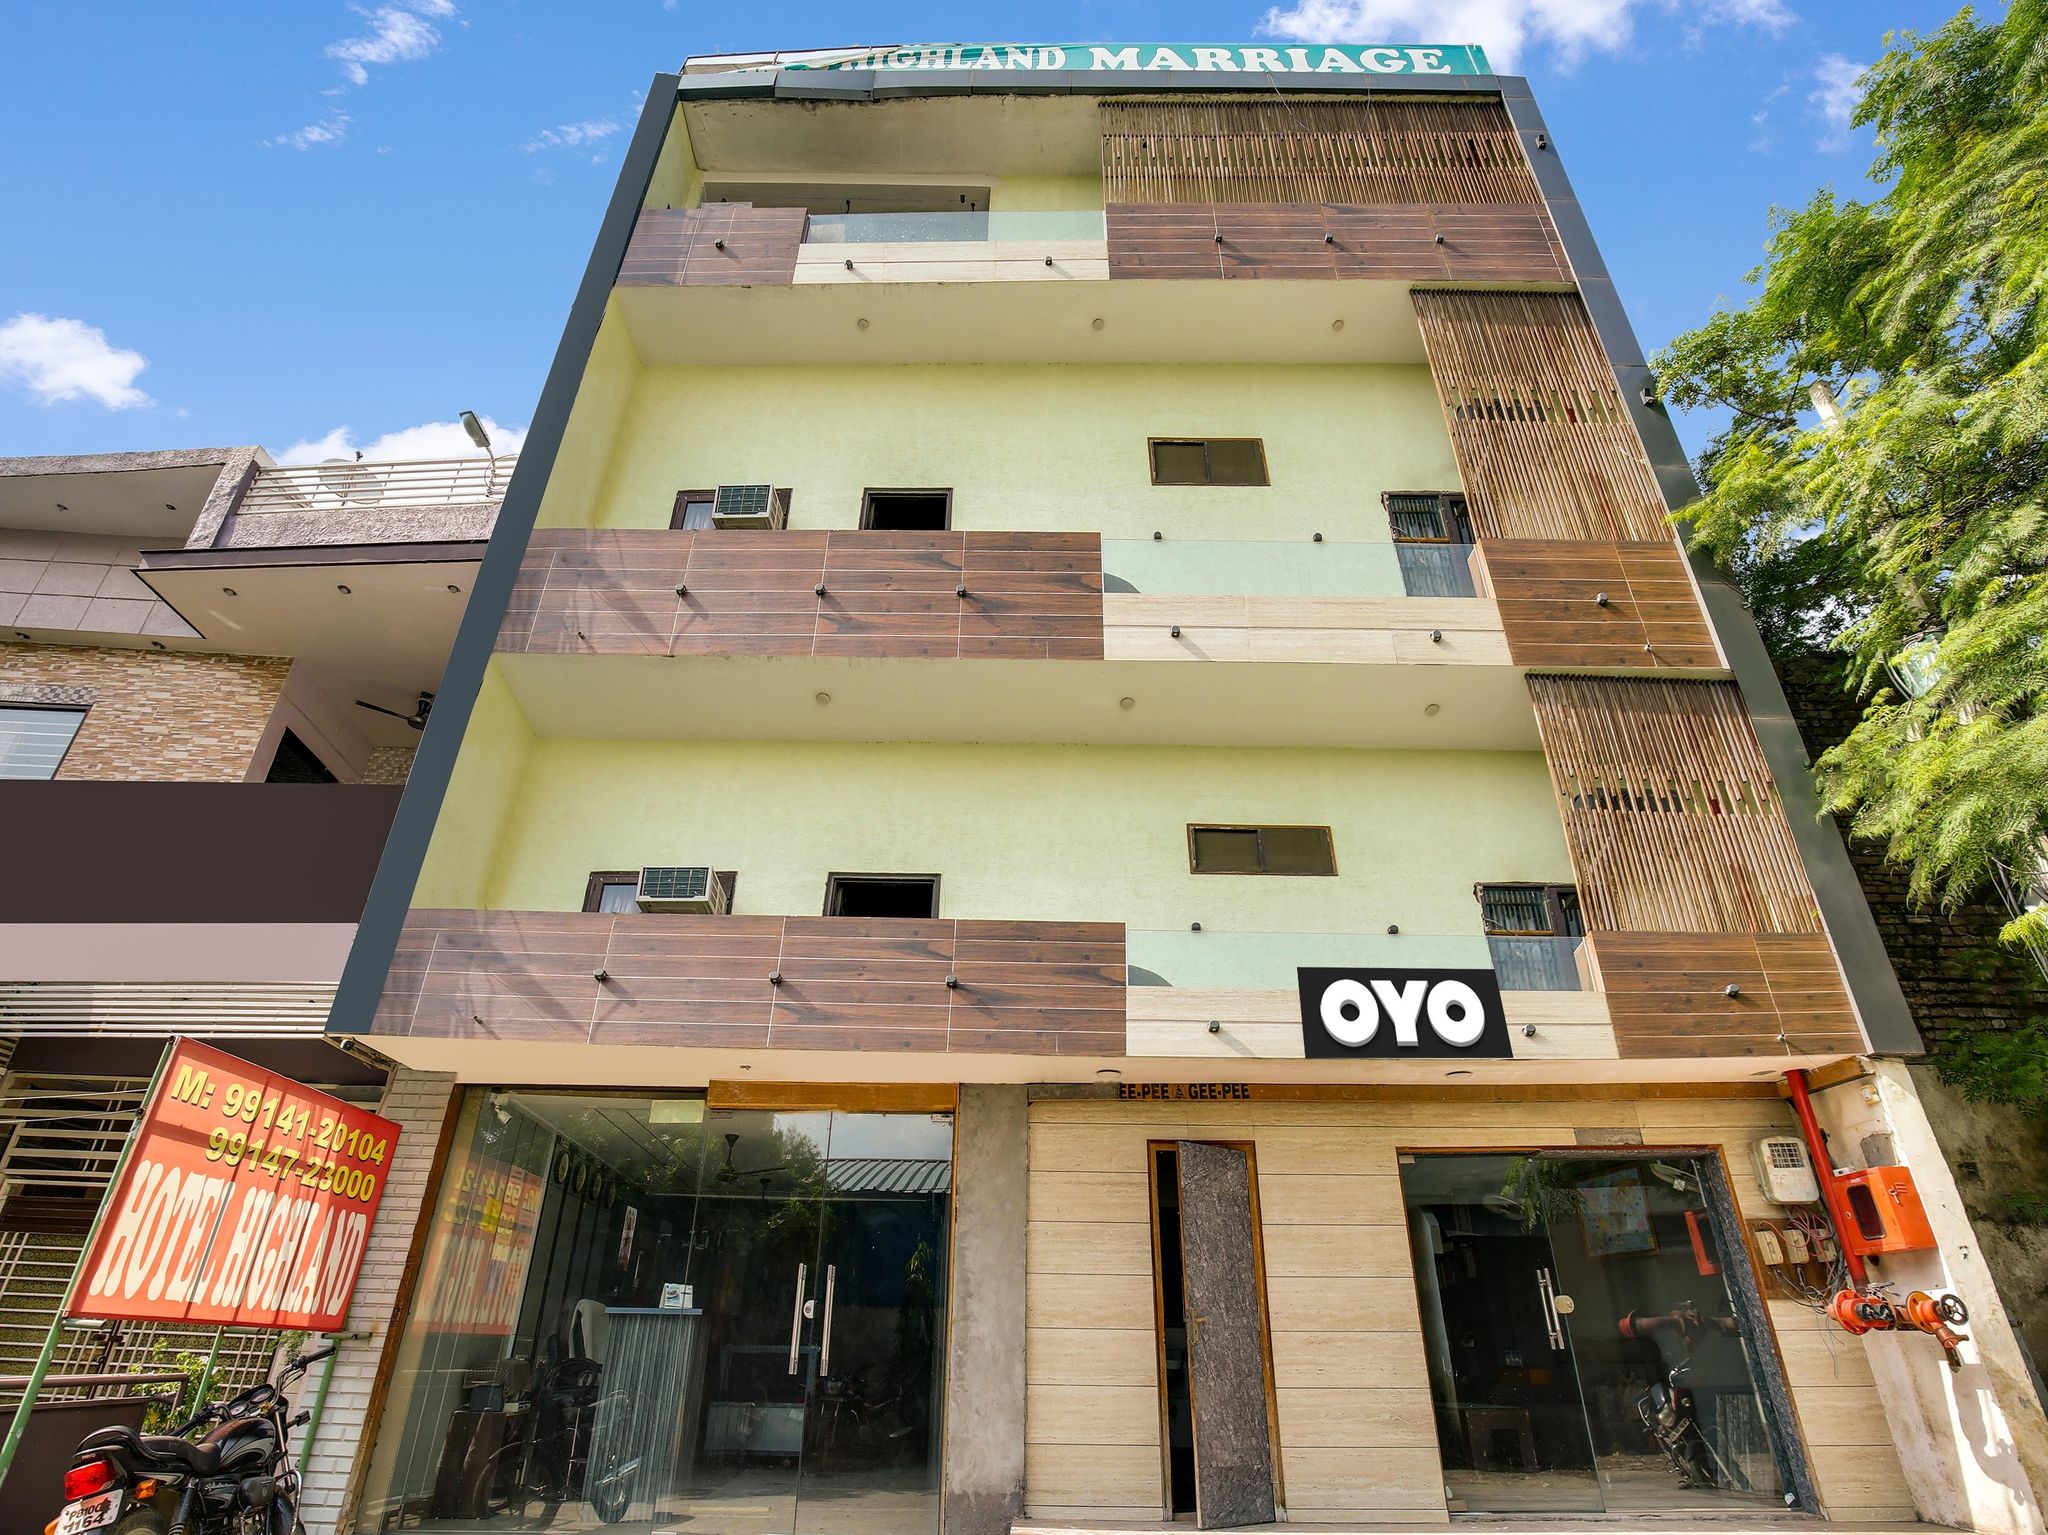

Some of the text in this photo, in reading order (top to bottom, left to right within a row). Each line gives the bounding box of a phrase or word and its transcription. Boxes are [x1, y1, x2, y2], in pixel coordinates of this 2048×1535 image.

[1089, 47, 1451, 74] MARRIAGE
[1320, 978, 1485, 1048] OYO
[170, 1063, 388, 1166] M: 99141-20104
[1188, 1083, 1250, 1100] GEE-PEE
[204, 1126, 376, 1202] 99147-23000
[89, 1159, 236, 1304] HOTEL
[210, 1186, 368, 1317] HIGHLAND
